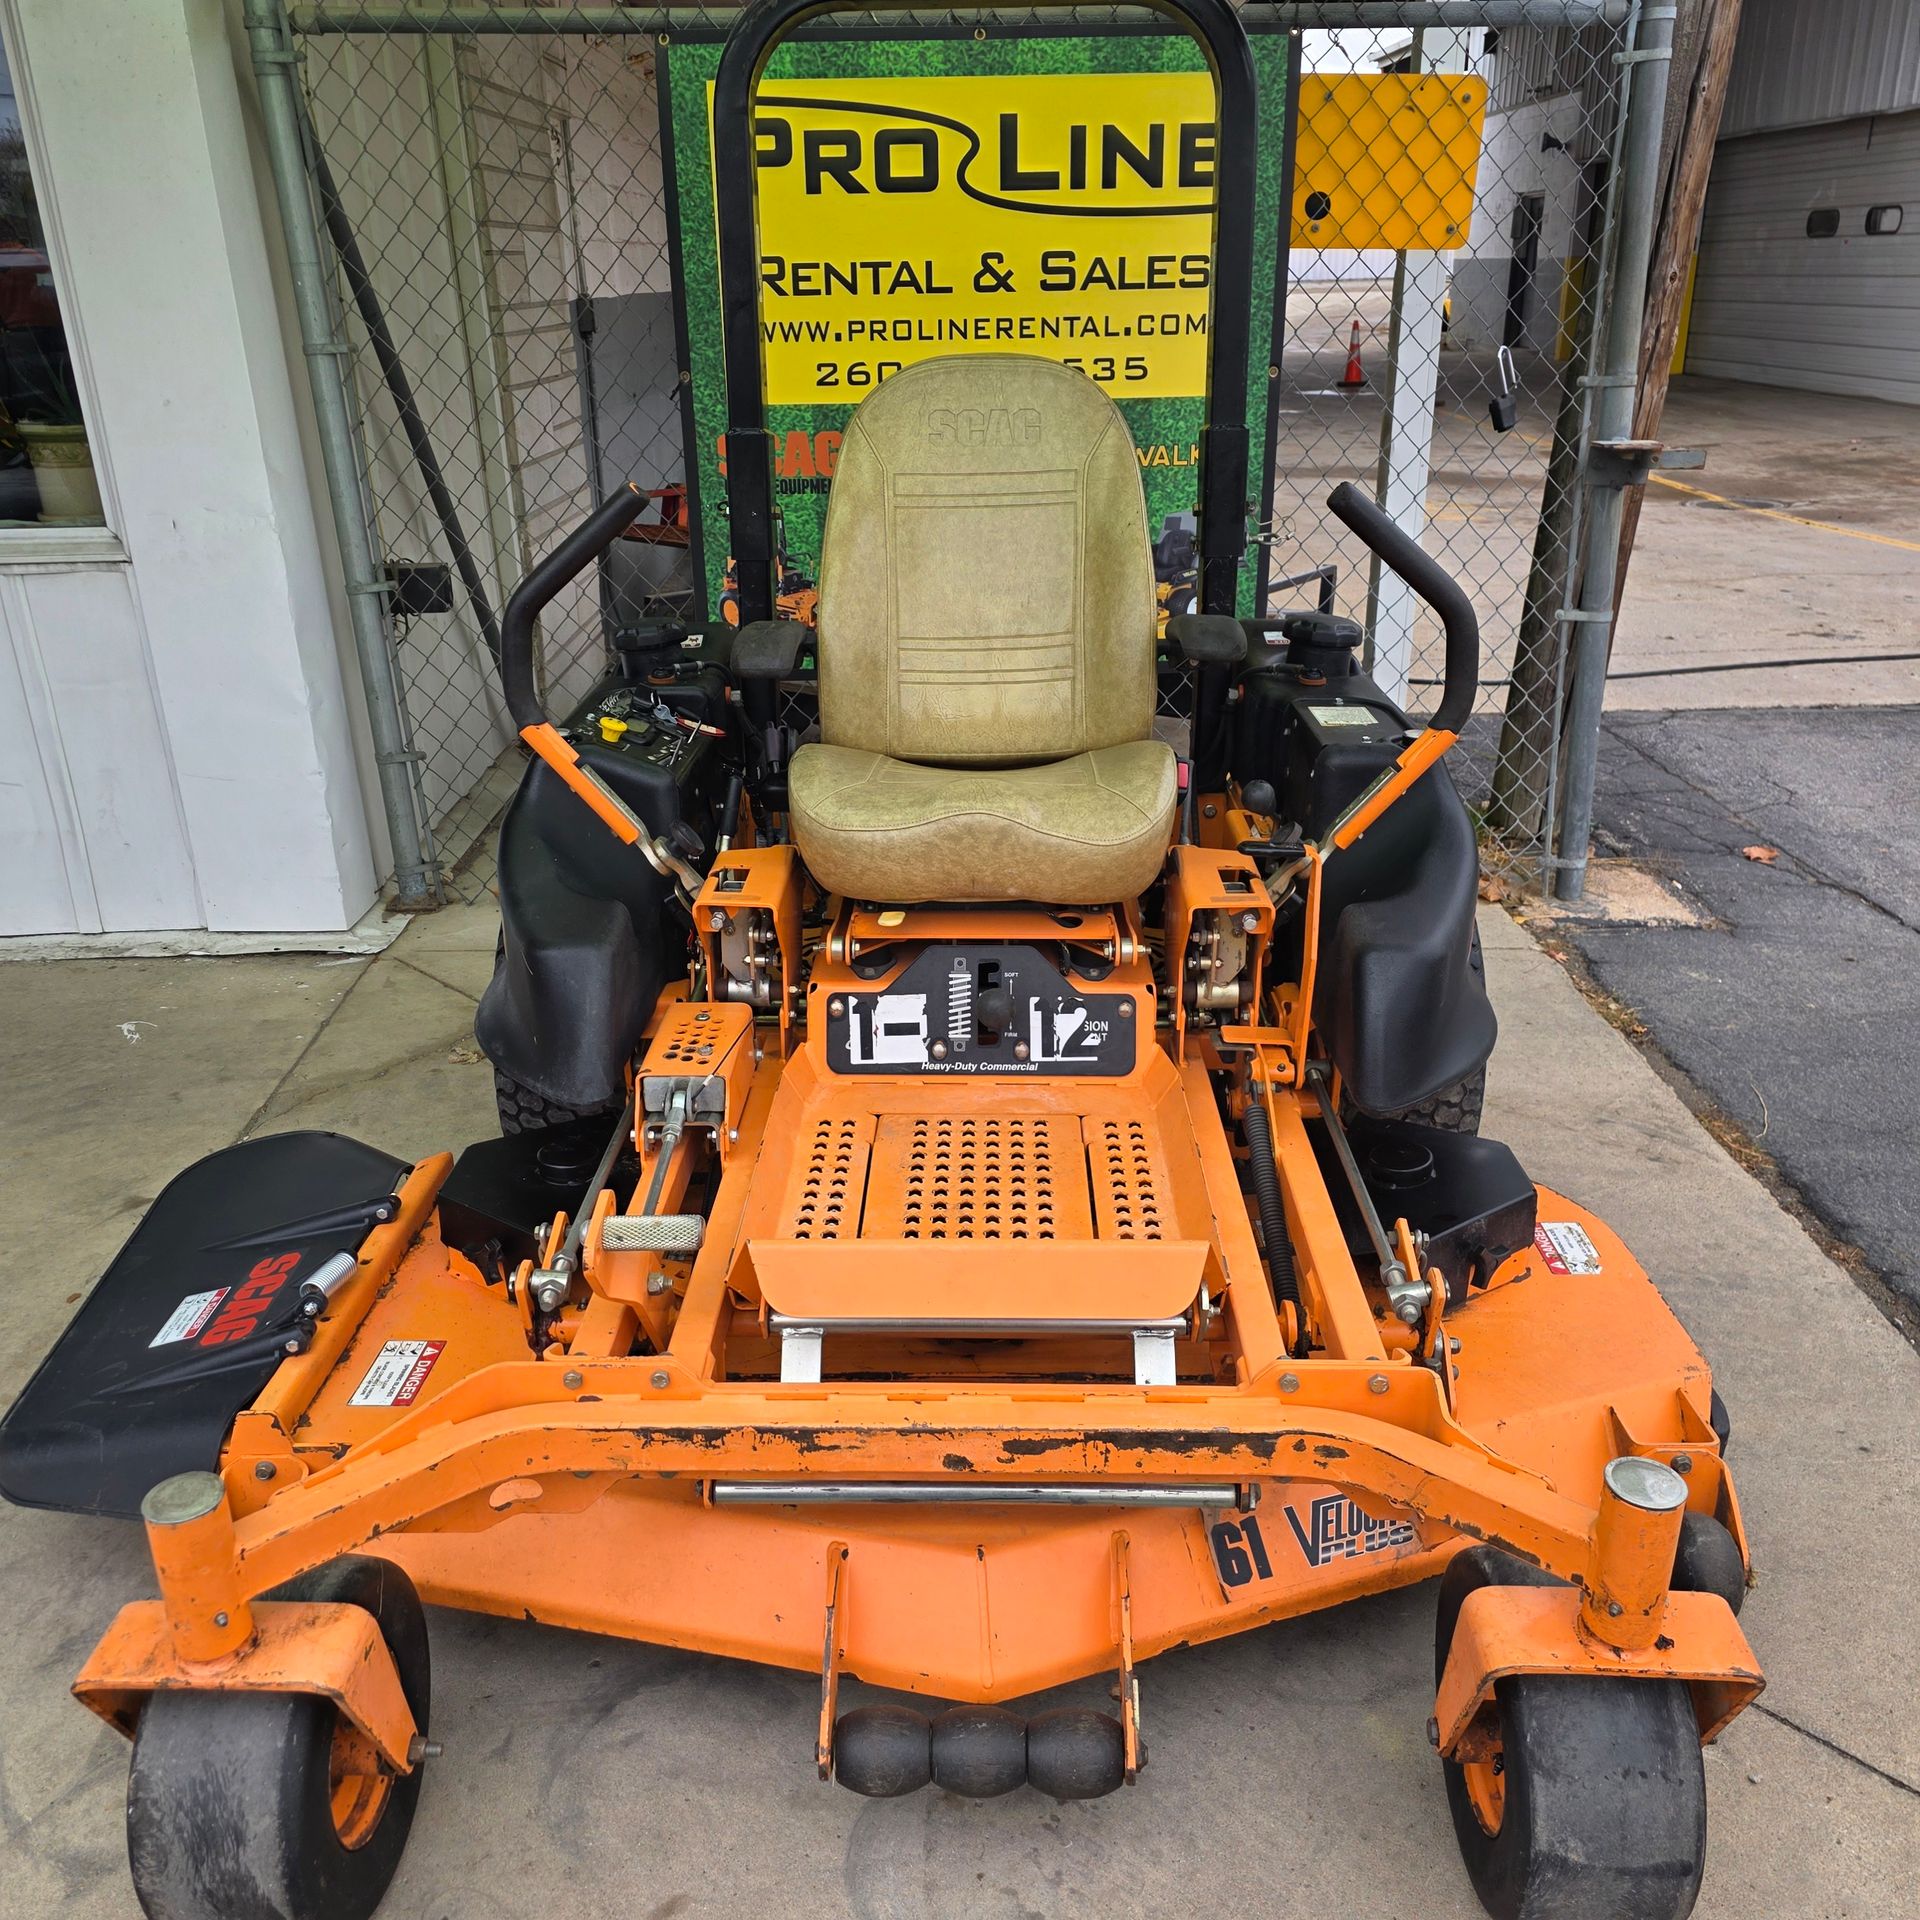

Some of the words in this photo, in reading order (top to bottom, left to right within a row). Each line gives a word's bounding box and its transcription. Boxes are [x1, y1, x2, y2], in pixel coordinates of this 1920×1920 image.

[755, 117, 939, 194] PRO
[999, 113, 1215, 191] LINE
[761, 256, 953, 296] RENTAL
[973, 251, 1016, 293] &
[1040, 250, 1210, 292] SALES
[928, 407, 1042, 448] SCAG
[775, 478, 831, 495] EQUIPME
[921, 1061, 978, 1072] Heavy-Duty
[979, 1061, 1039, 1072] Commercial
[199, 1251, 302, 1346] SCAG
[397, 1360, 431, 1399] DANGER
[1211, 1515, 1274, 1588] 61
[1320, 1524, 1415, 1565] PLUS
